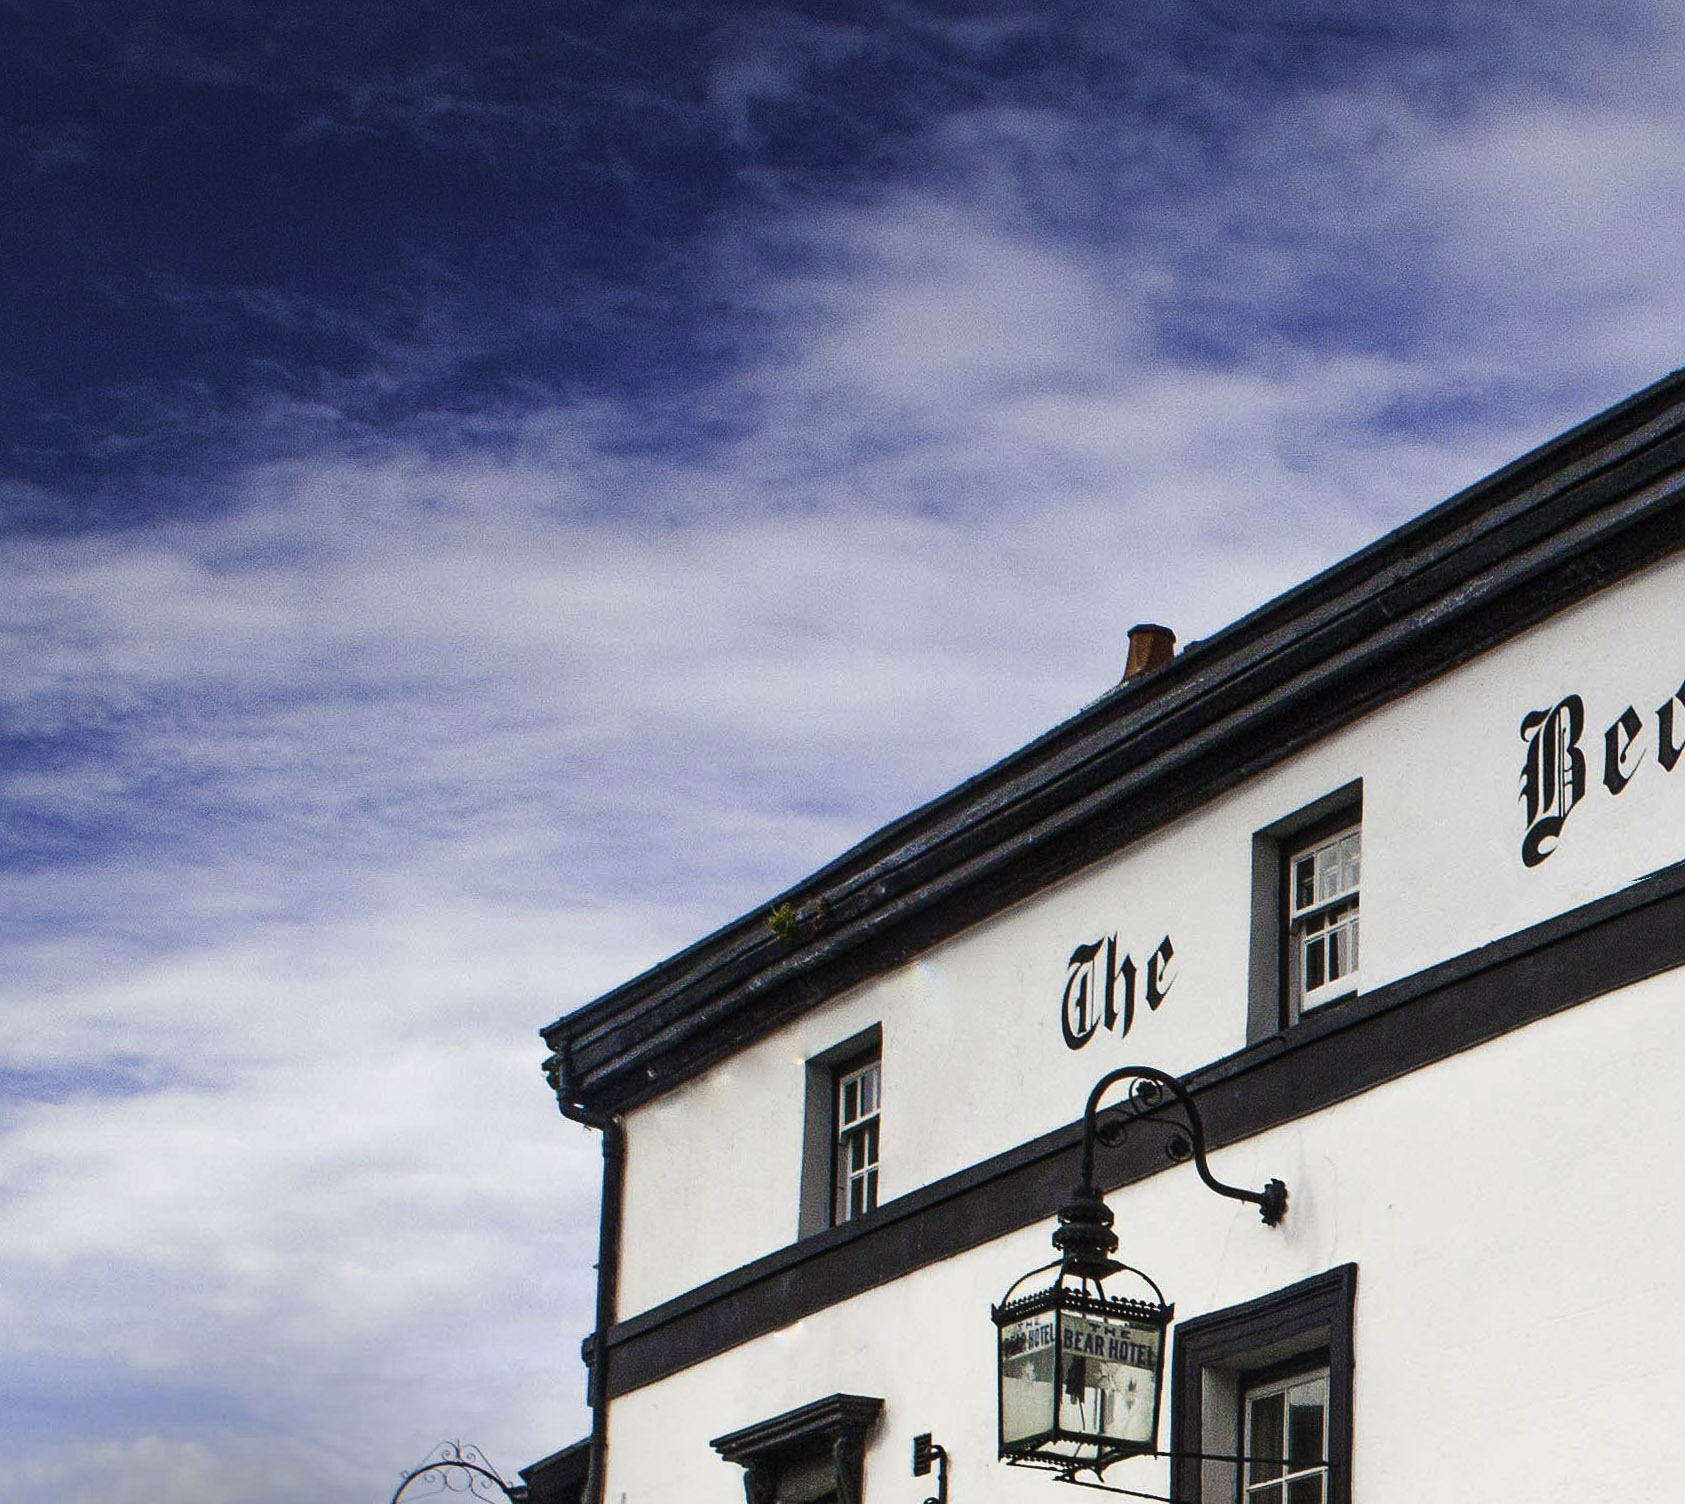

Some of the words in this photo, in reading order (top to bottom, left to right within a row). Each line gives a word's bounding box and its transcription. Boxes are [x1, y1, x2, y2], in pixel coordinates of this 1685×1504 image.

[1060, 930, 1178, 1051] The
[1063, 1327, 1105, 1358] BEAR
[1108, 1337, 1157, 1369] HOTEL
[1088, 1322, 1132, 1339] THE
